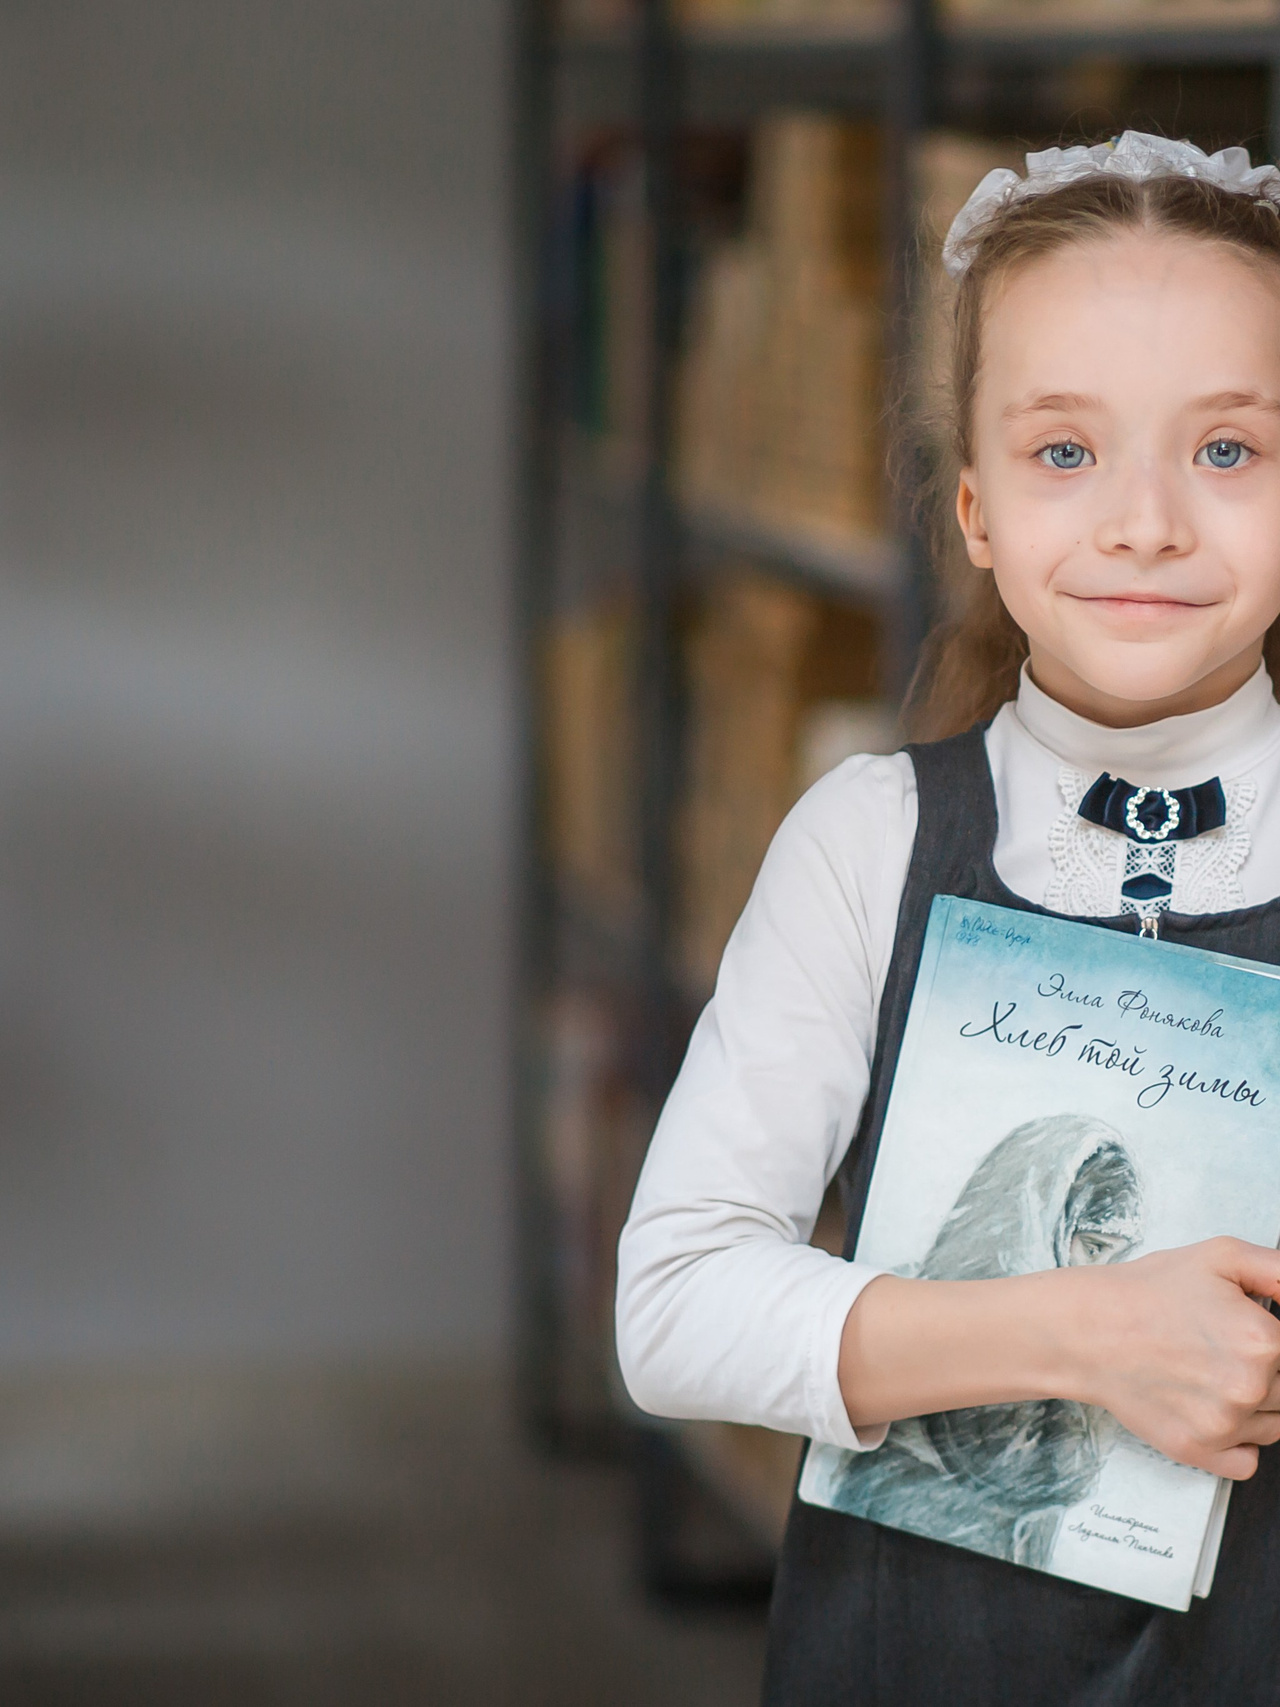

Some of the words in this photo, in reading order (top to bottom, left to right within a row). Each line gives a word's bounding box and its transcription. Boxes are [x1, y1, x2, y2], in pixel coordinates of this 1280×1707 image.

[1037, 973, 1104, 1008] Элла
[1117, 989, 1225, 1038] Фонякова
[960, 1001, 1082, 1057] Хлеб
[1077, 1038, 1145, 1076] той
[1137, 1064, 1266, 1109] зимы
